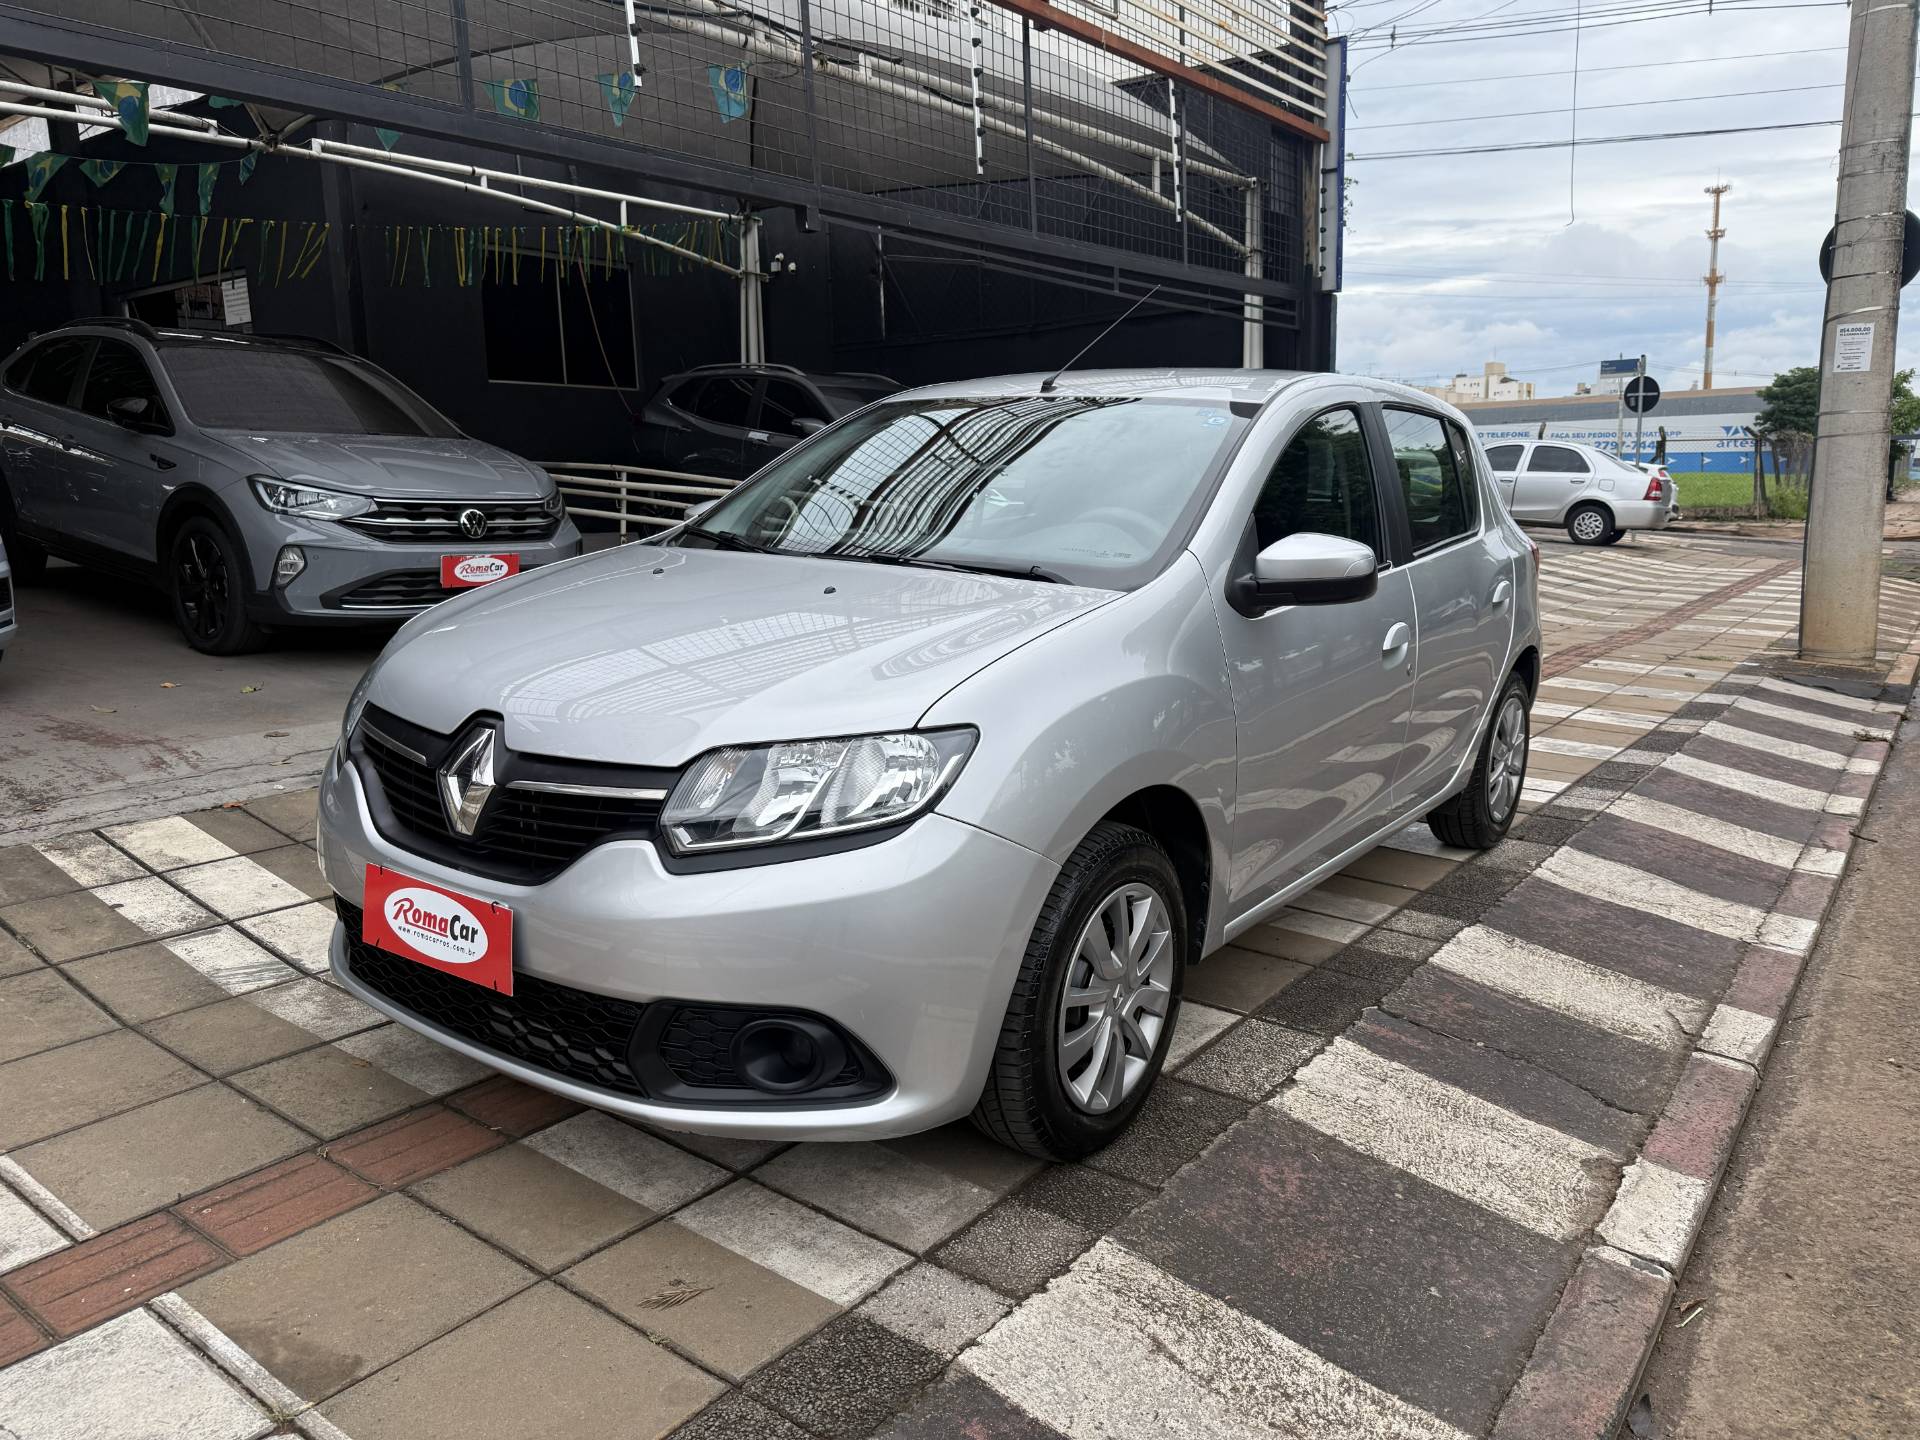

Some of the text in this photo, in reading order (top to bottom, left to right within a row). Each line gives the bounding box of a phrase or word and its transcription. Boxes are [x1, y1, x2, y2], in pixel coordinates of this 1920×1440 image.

[1487, 431, 1530, 439] TELEFONE
[1588, 431, 1617, 439] PEDIDO
[460, 563, 504, 574] RomaCar
[393, 898, 478, 943] RomaCar
